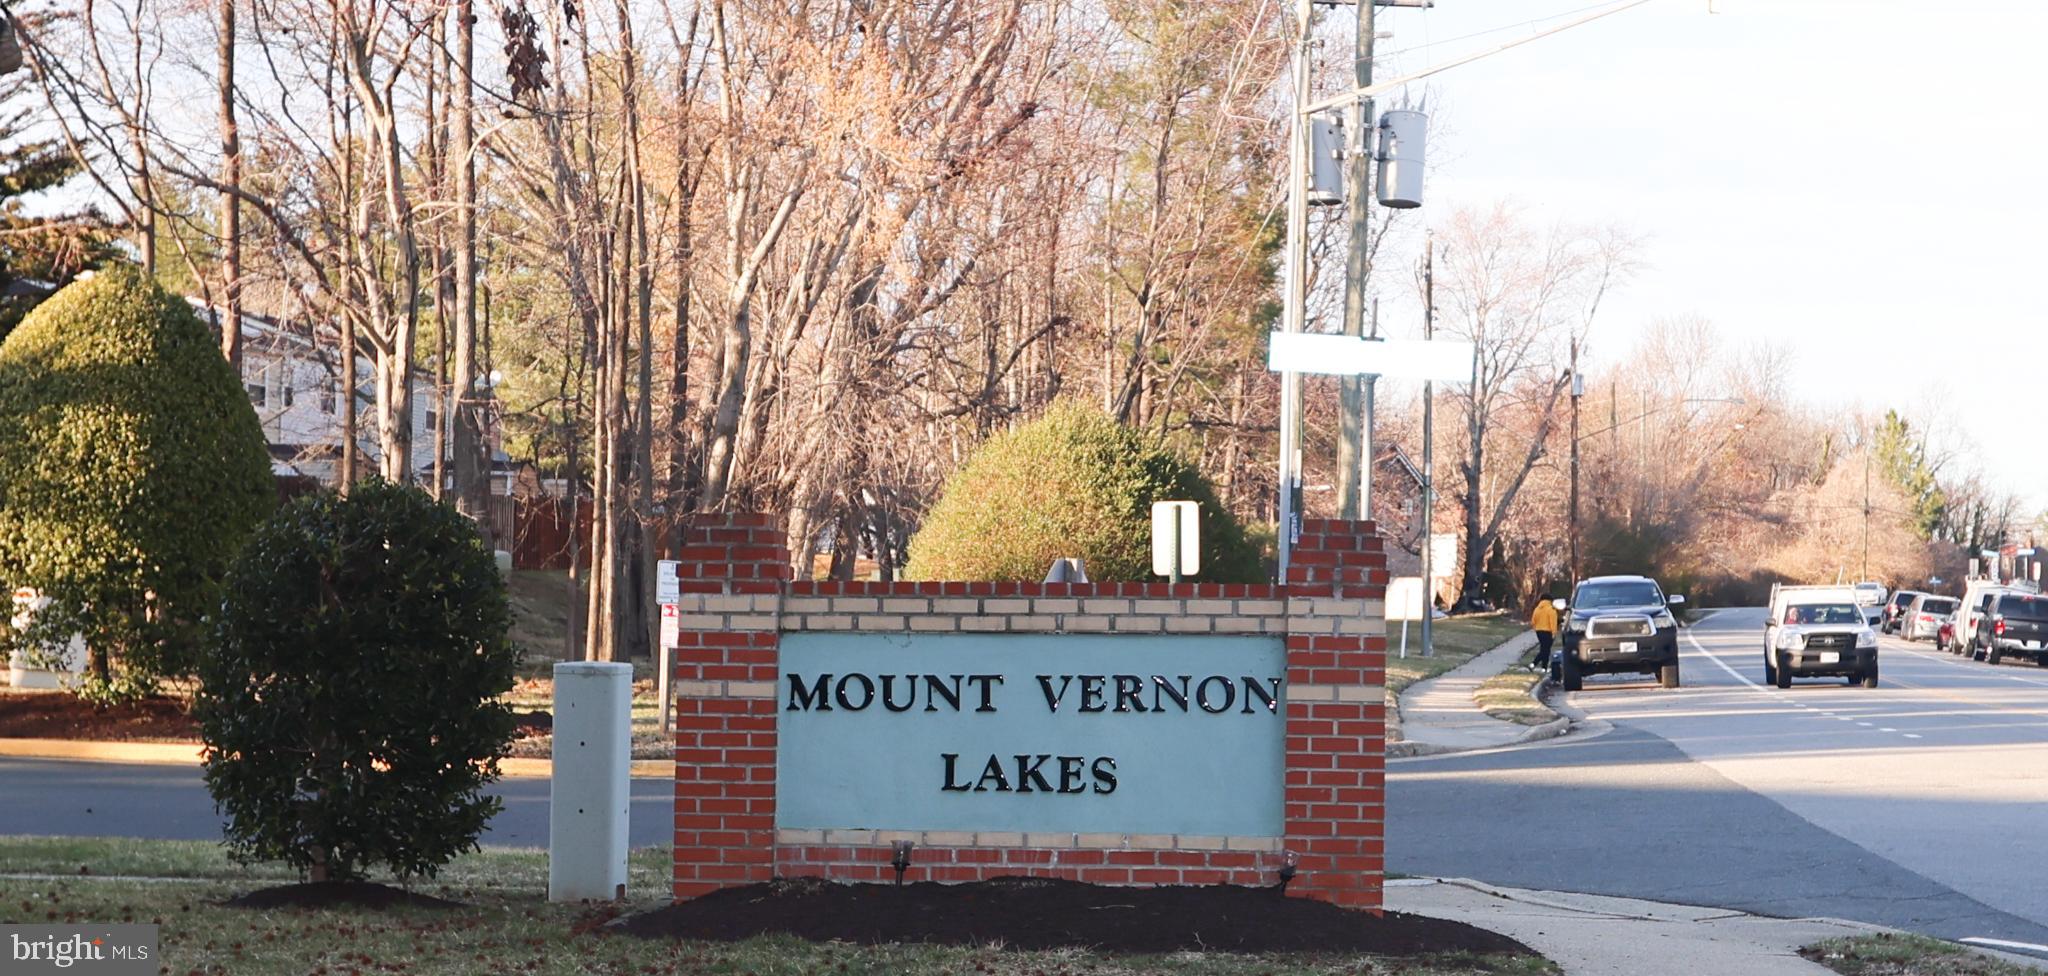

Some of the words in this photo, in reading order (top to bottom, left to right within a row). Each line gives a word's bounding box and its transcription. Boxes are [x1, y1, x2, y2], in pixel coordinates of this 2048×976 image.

[786, 673, 1004, 714] MOUNT
[1036, 674, 1282, 715] VERNON
[941, 753, 1118, 795] LAKES
